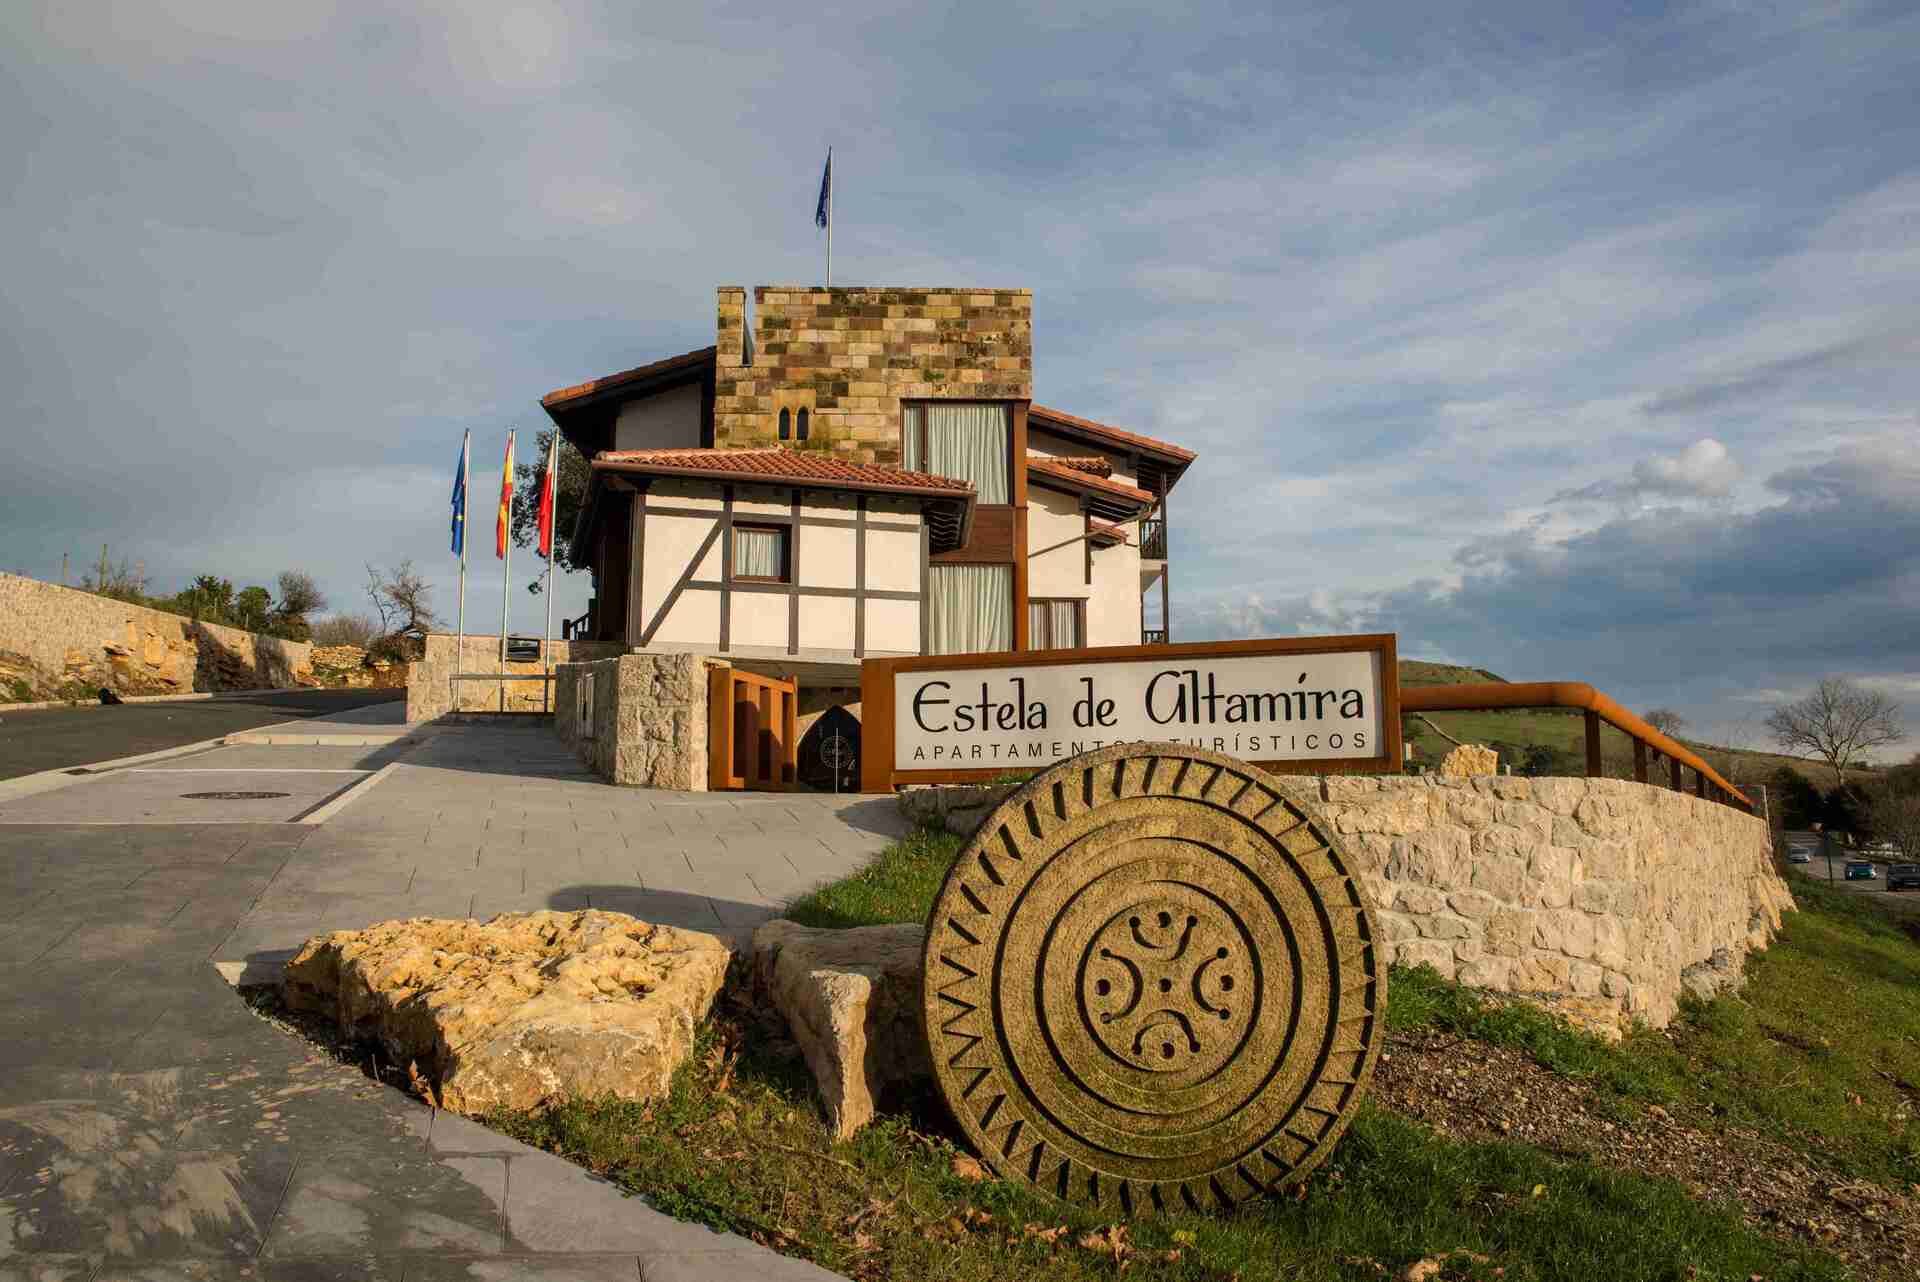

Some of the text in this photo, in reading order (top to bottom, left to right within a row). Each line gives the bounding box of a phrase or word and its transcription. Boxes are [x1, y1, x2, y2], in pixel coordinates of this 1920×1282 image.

[912, 680, 1047, 733] Estela
[1073, 677, 1118, 728] de
[913, 732, 1367, 761] APARTAMENT URÍSTICOS
